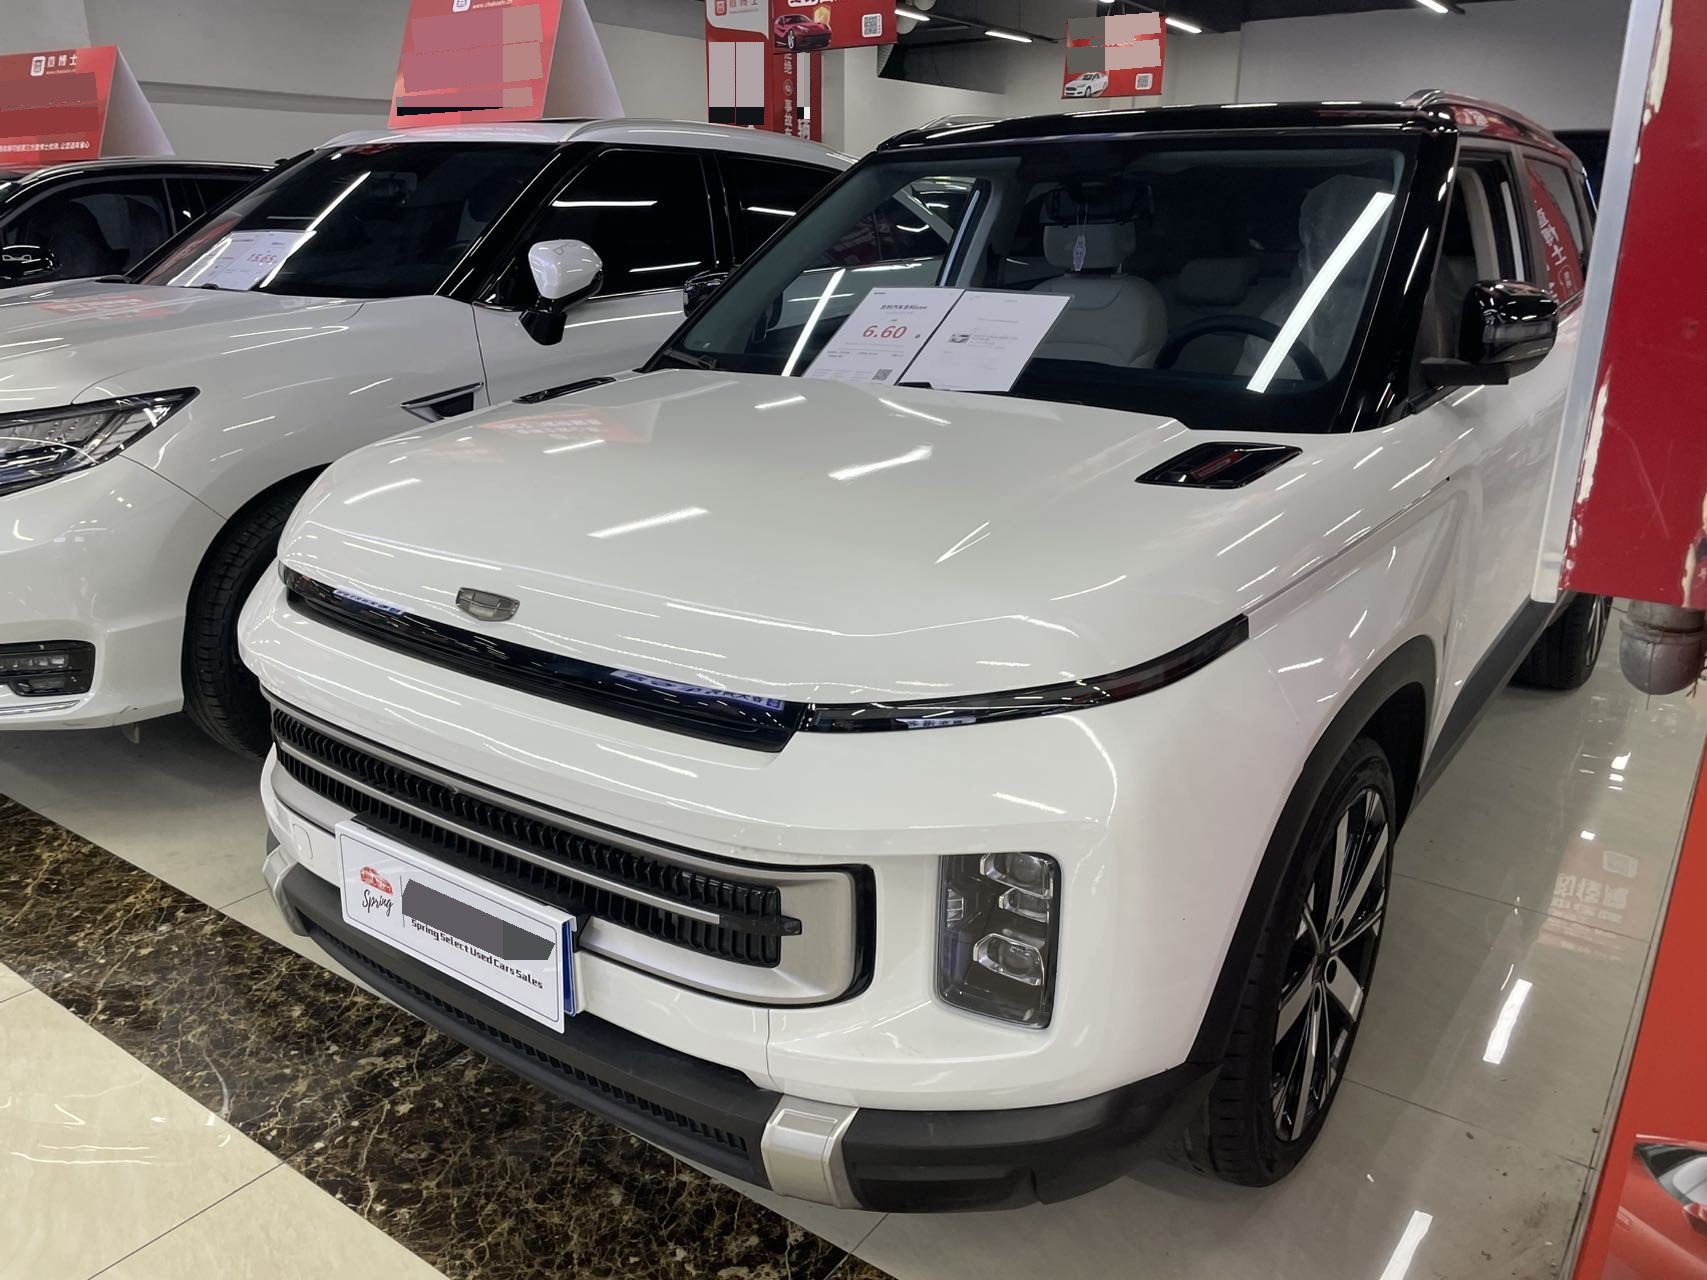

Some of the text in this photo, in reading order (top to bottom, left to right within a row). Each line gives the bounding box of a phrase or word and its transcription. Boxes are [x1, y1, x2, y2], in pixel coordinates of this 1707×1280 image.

[863, 325, 908, 339] 6.60
[362, 889, 393, 917] Spring
[411, 918, 544, 990] Spring Select Used Cars Sales
